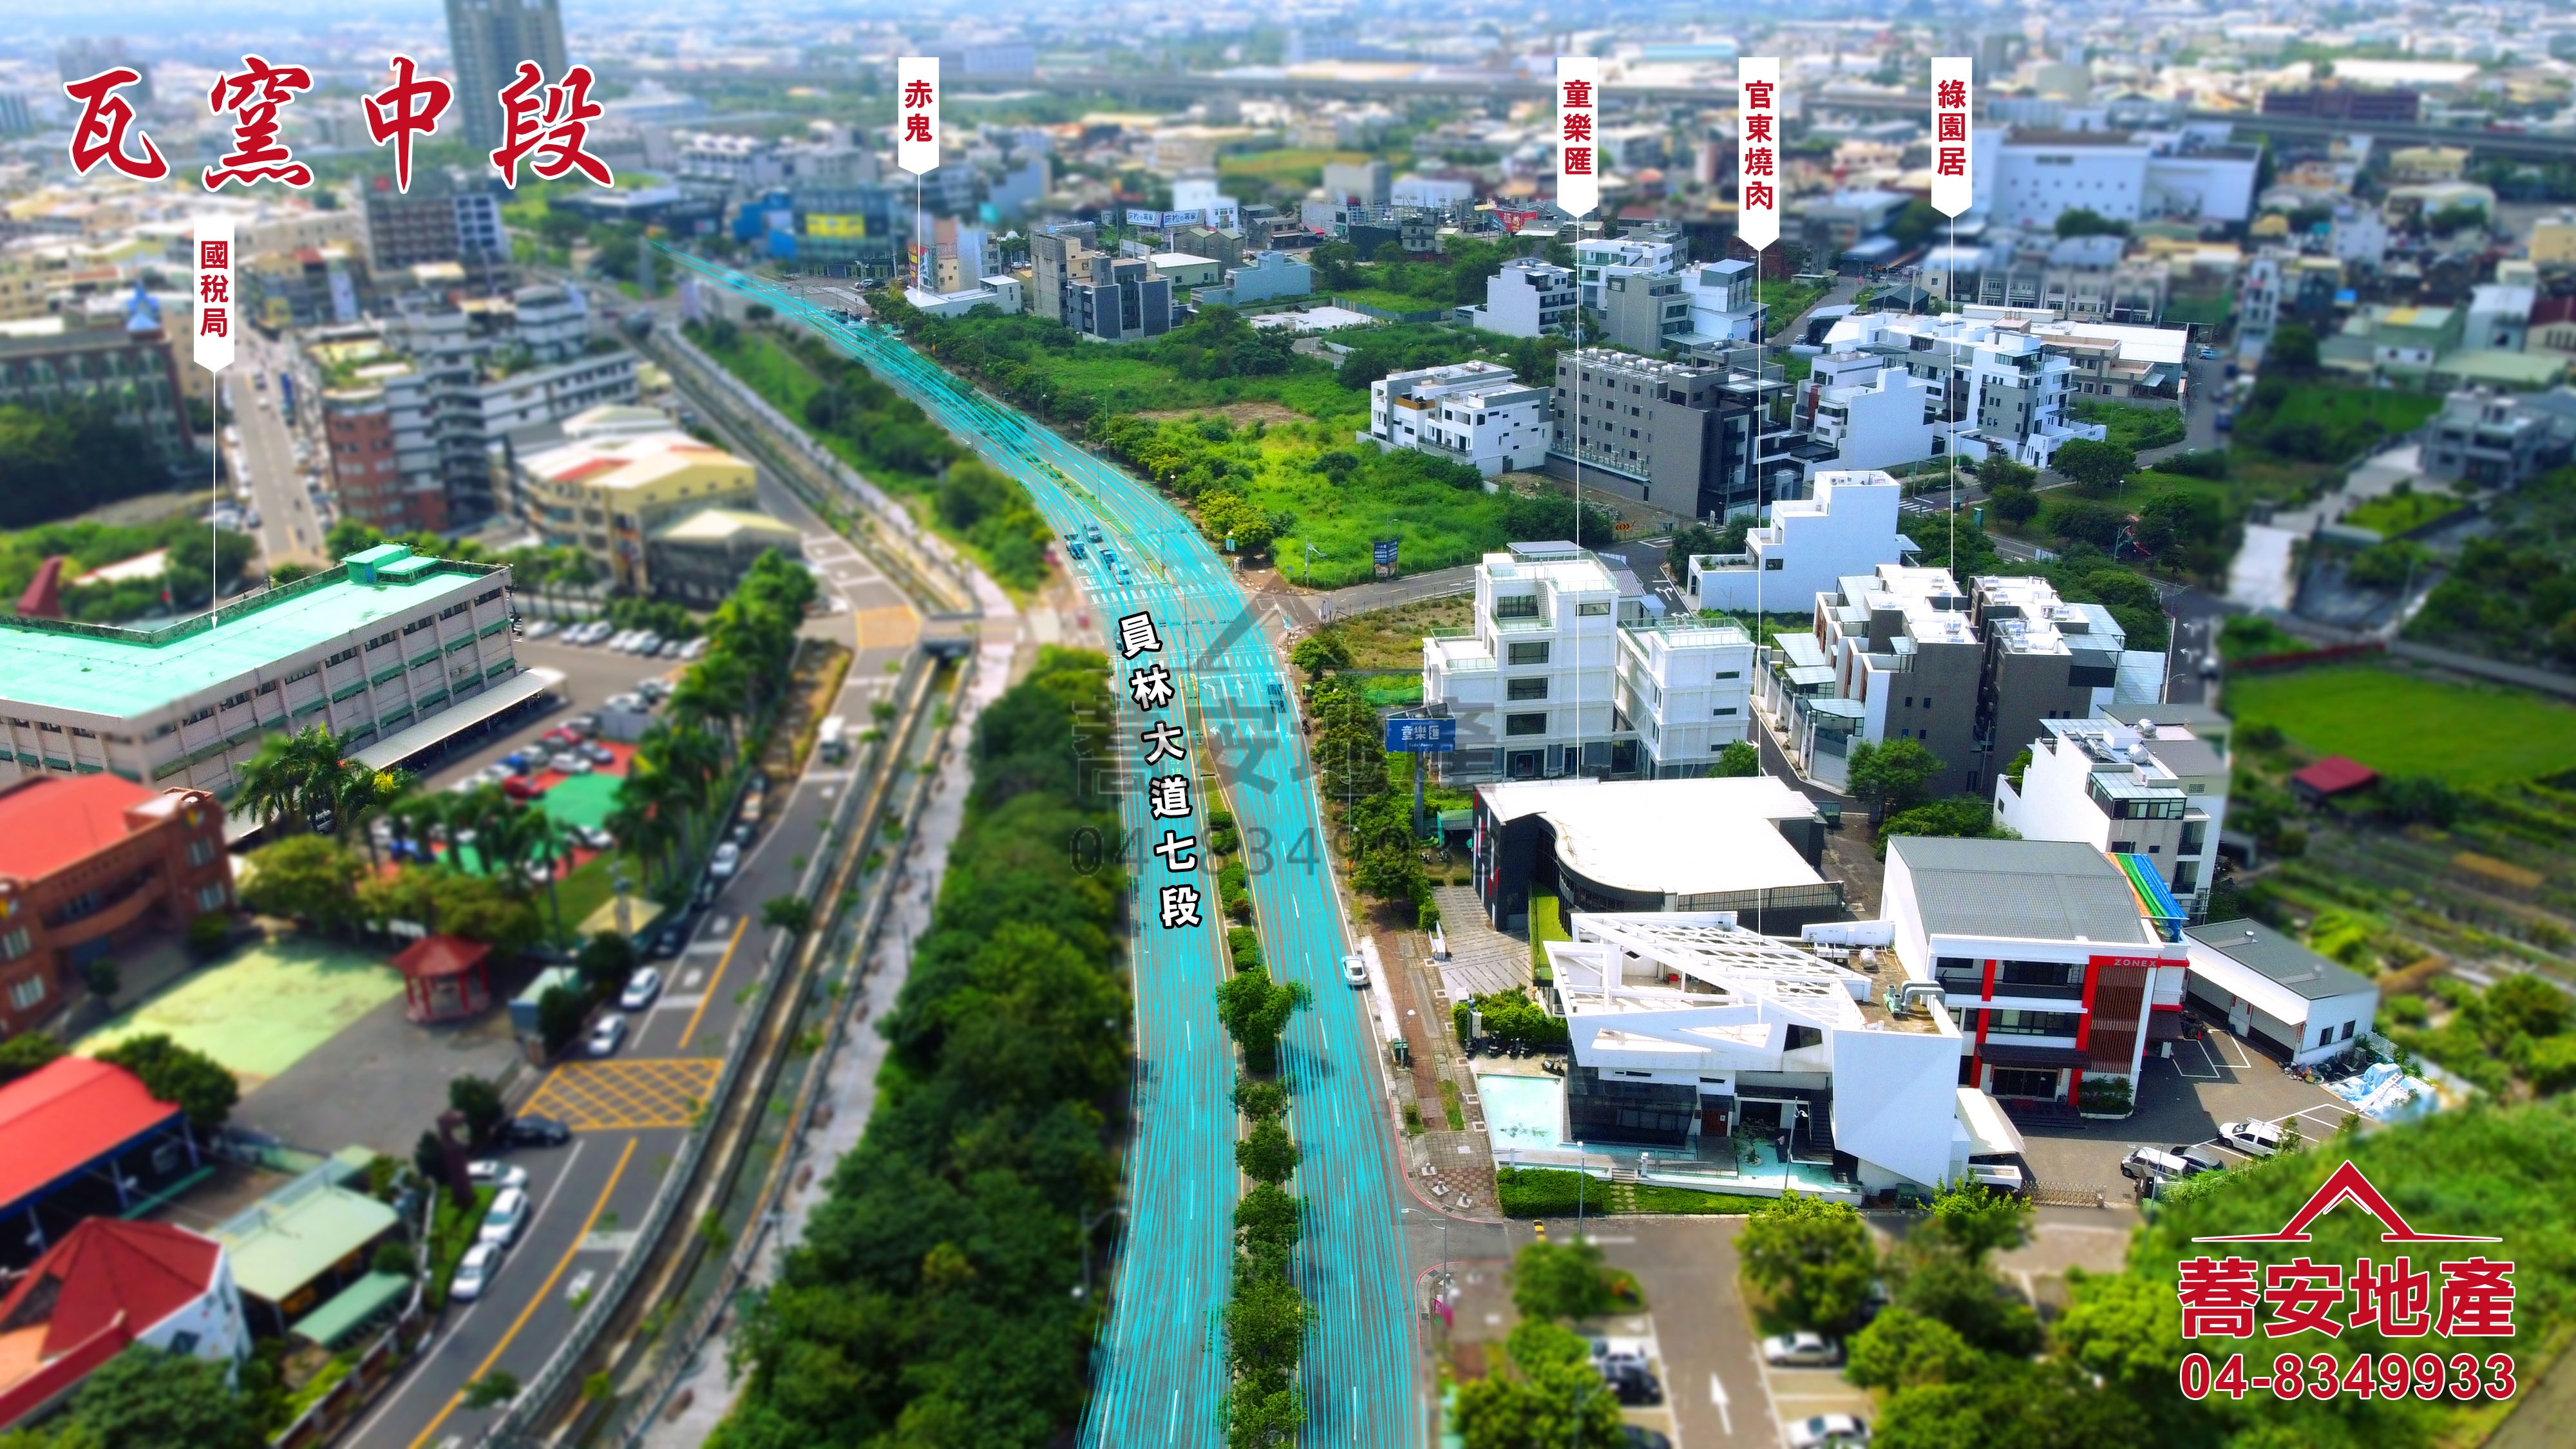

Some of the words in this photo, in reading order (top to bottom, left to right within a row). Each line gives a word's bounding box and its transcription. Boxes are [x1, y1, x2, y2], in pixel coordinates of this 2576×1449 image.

[1401, 724, 1440, 741] 童樂匯
[2114, 958, 2156, 967] ZONEX
